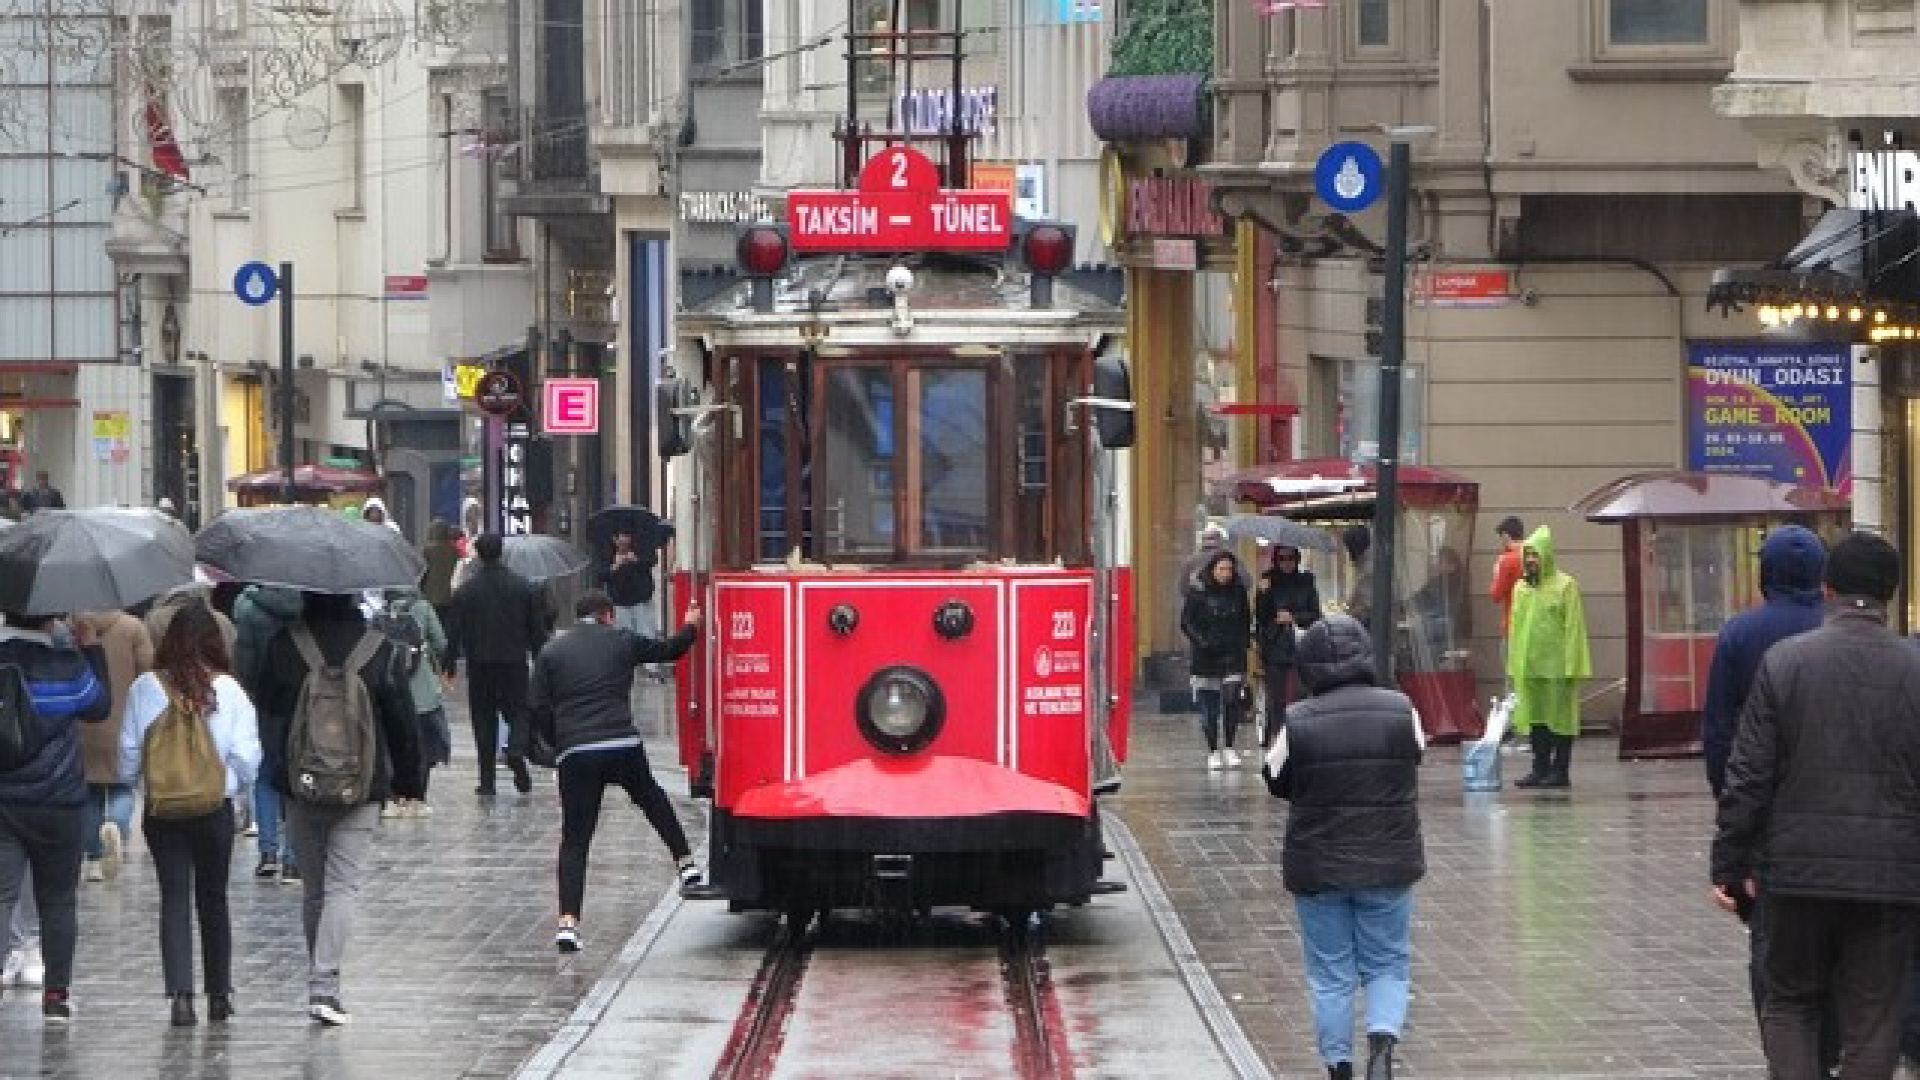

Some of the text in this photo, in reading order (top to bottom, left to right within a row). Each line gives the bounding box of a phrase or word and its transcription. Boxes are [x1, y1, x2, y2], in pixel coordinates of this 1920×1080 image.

[891, 152, 909, 187] 2
[796, 198, 878, 235] TAKSİM
[930, 197, 1004, 232] TÜNEL
[558, 390, 585, 420] E
